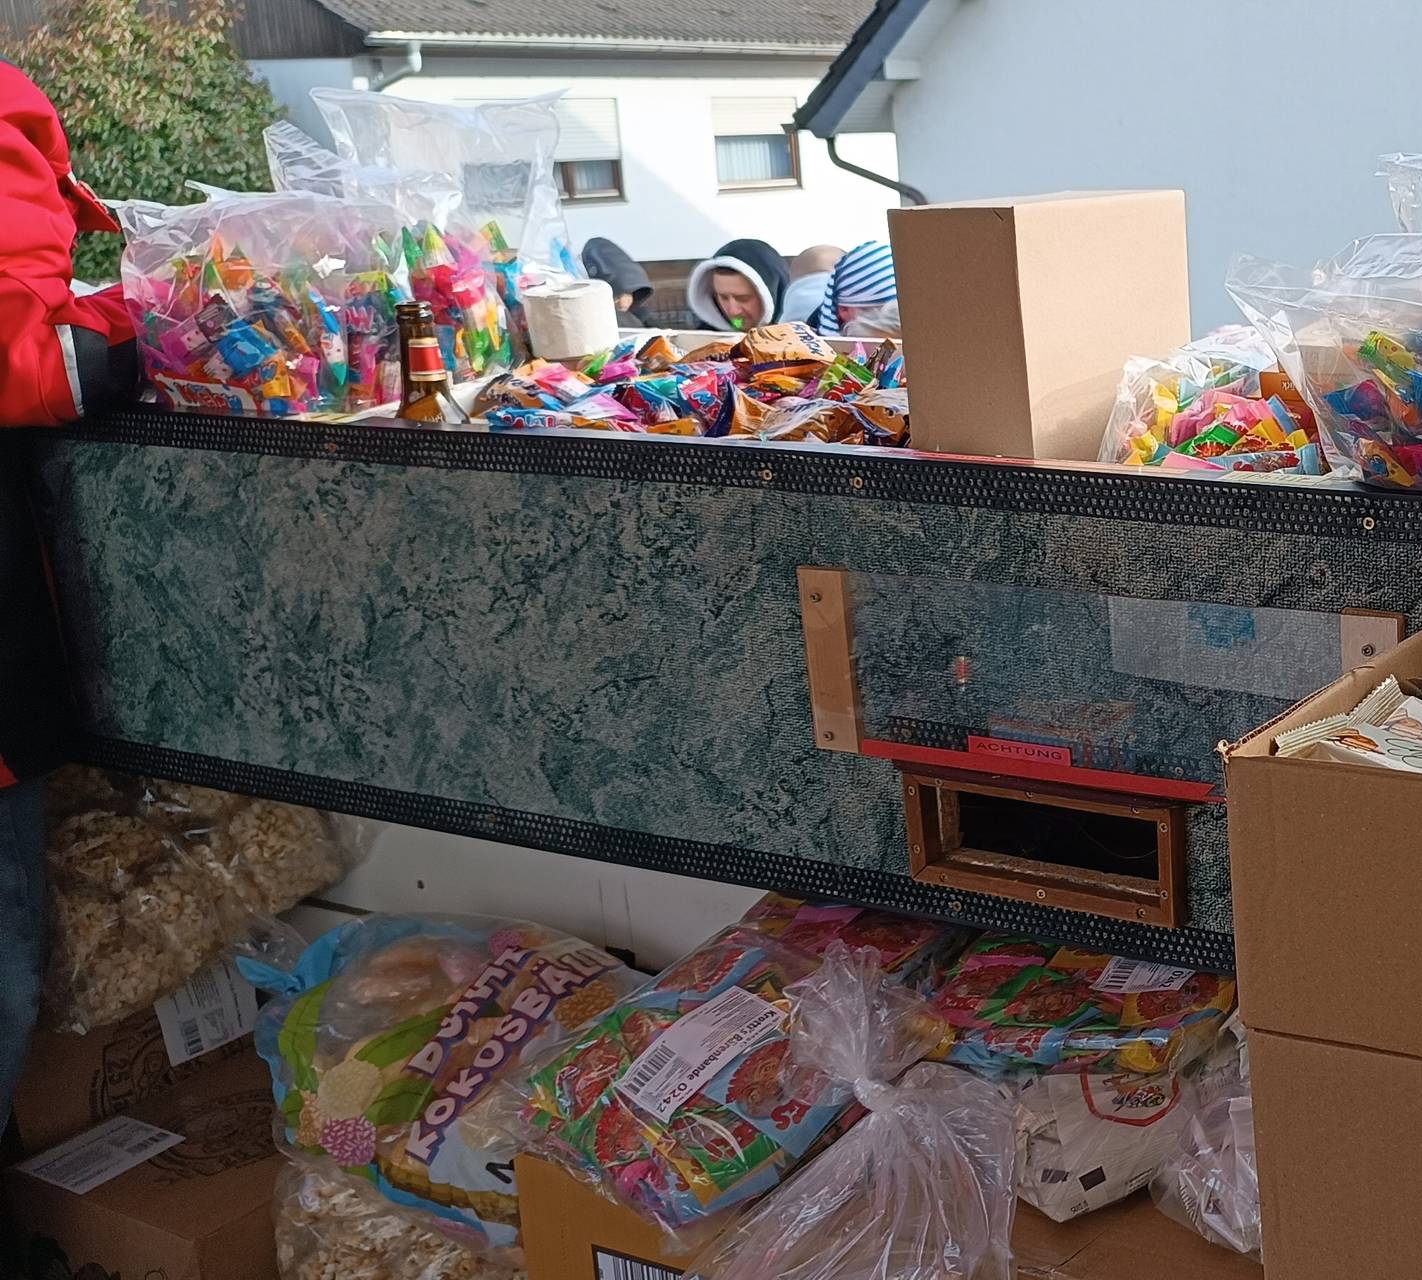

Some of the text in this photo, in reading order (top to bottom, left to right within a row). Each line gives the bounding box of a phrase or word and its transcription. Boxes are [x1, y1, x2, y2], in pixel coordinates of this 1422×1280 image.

[976, 742, 1063, 760] ACHTUNG
[688, 1034, 744, 1081] Bärenbande
[656, 1083, 689, 1113] 0242
